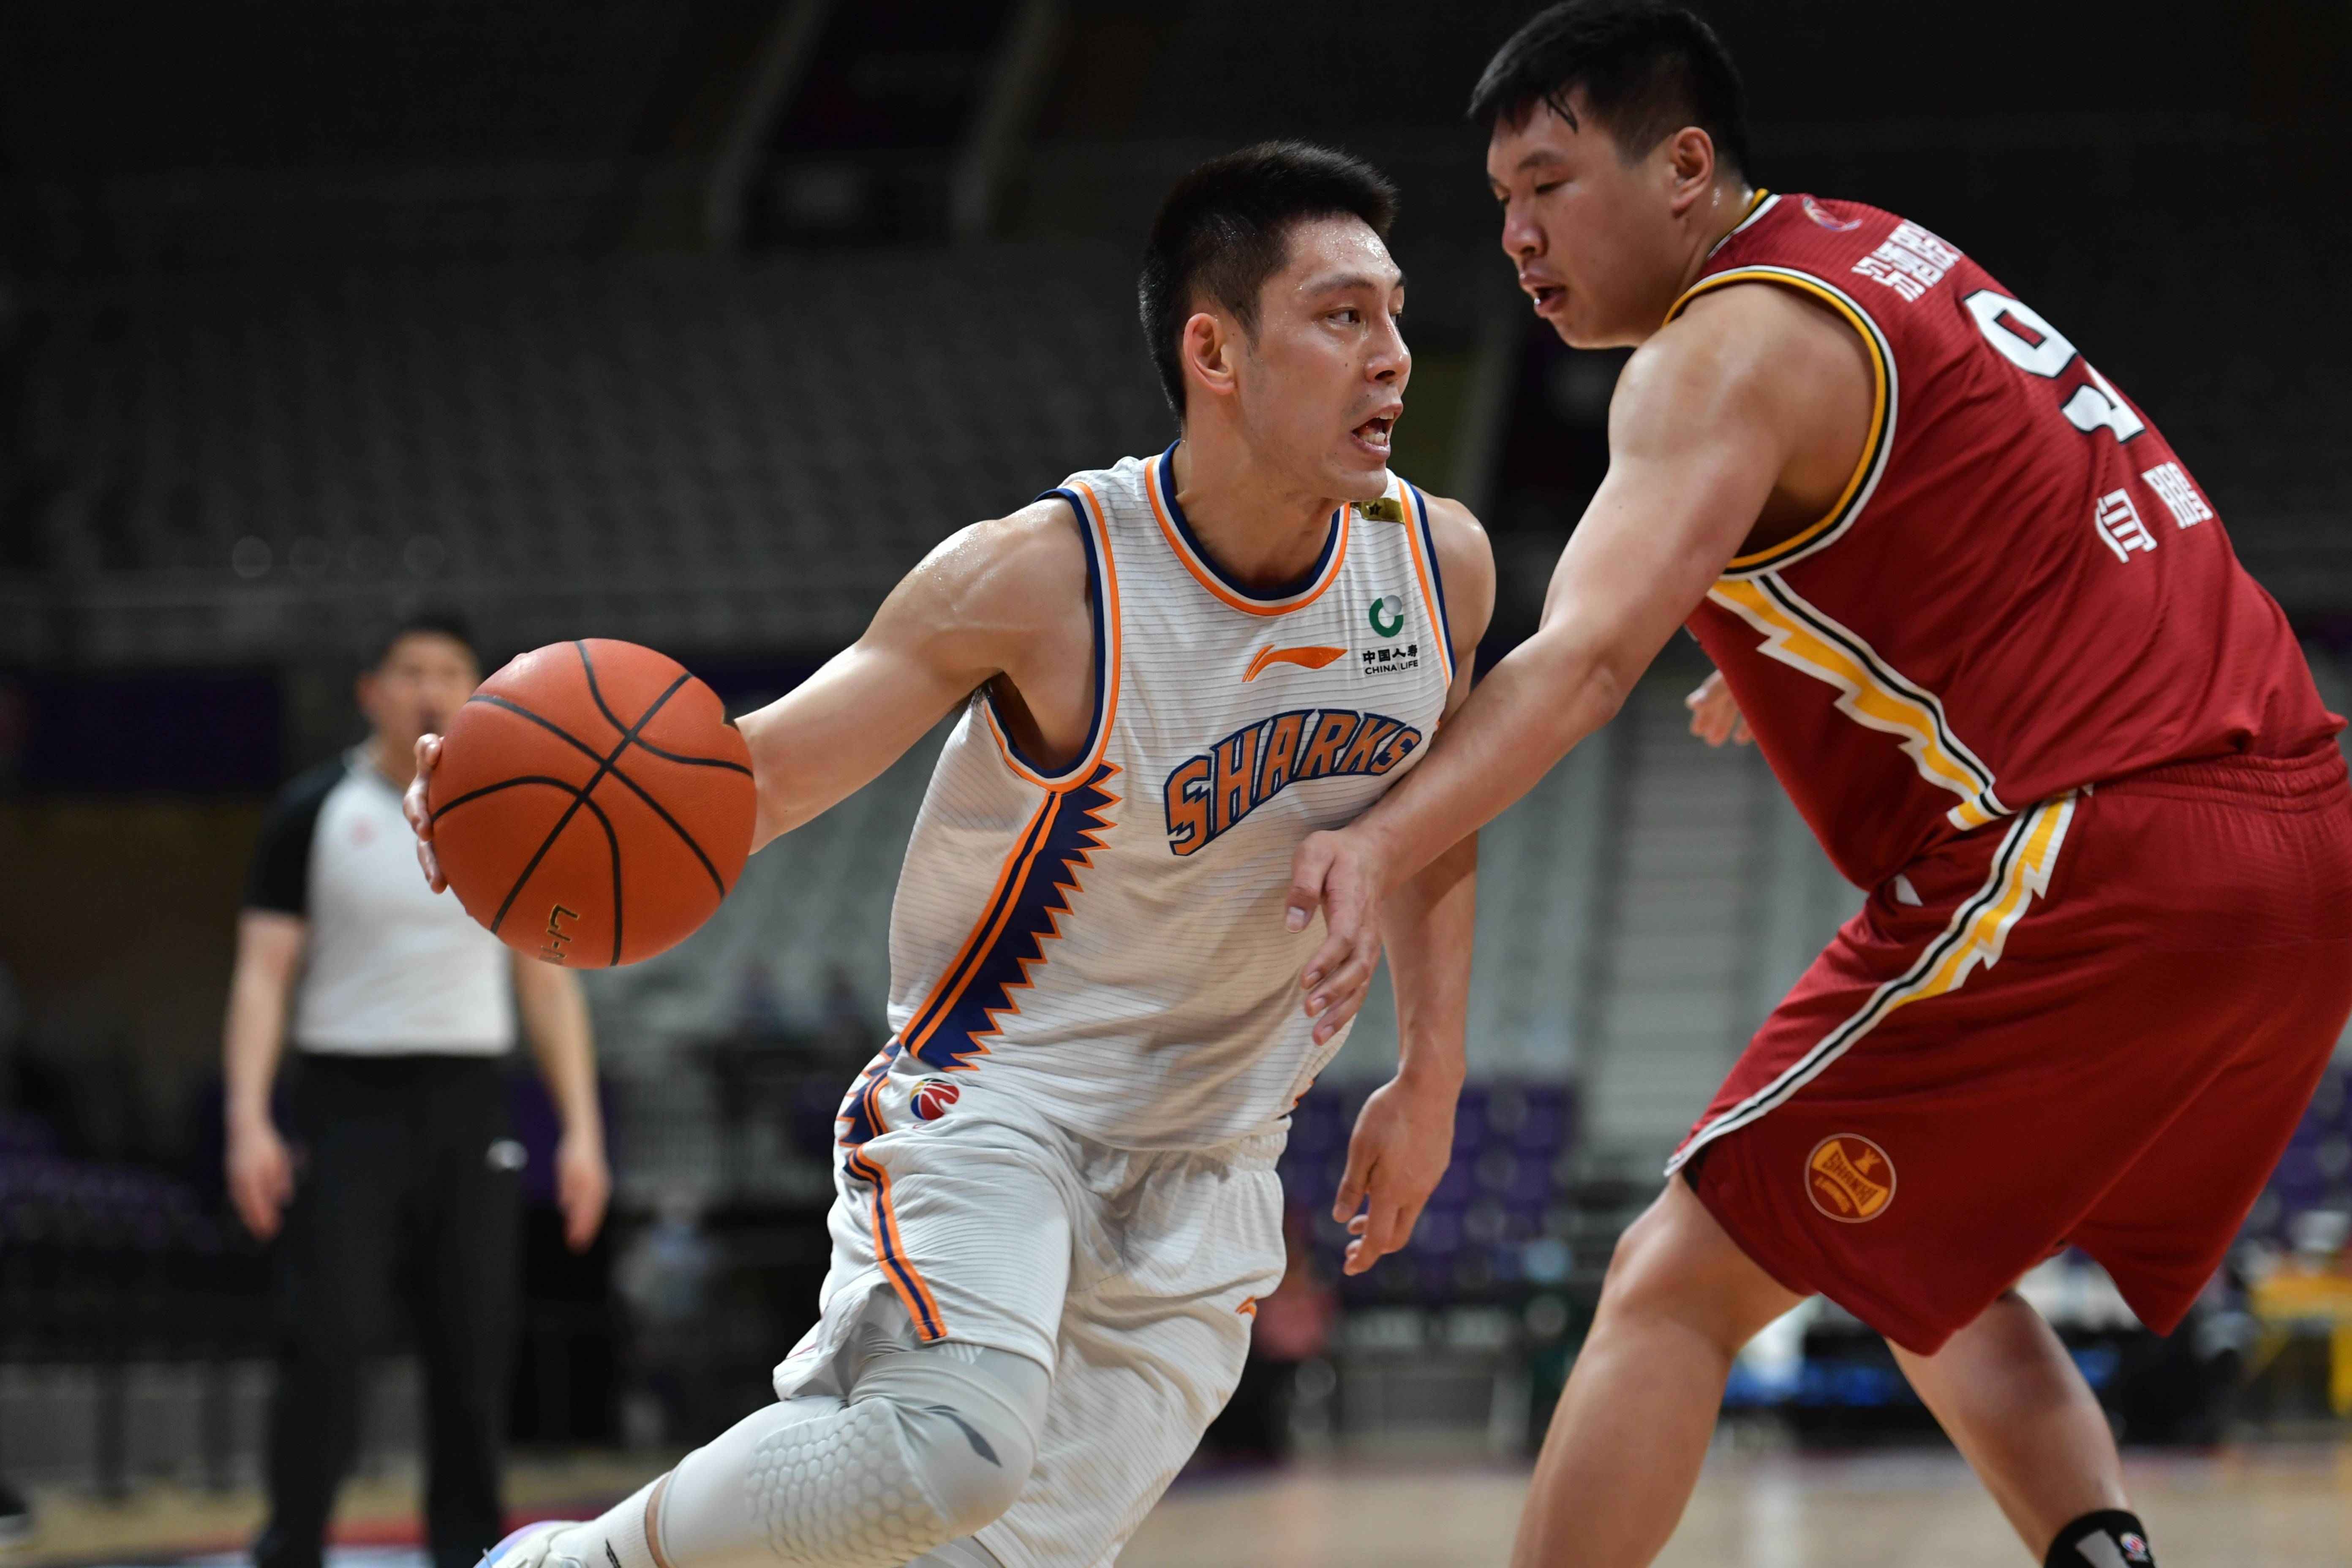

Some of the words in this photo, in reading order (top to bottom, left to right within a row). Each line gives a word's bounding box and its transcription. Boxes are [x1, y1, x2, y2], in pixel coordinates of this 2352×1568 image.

[1850, 218, 1965, 303] 汾酒股
[1962, 289, 2146, 444] 9
[1362, 644, 1418, 664] 中国人寿
[1365, 664, 1397, 675] CHINA
[1400, 659, 1418, 670] LIFE
[1163, 708, 1422, 857] SHARKS
